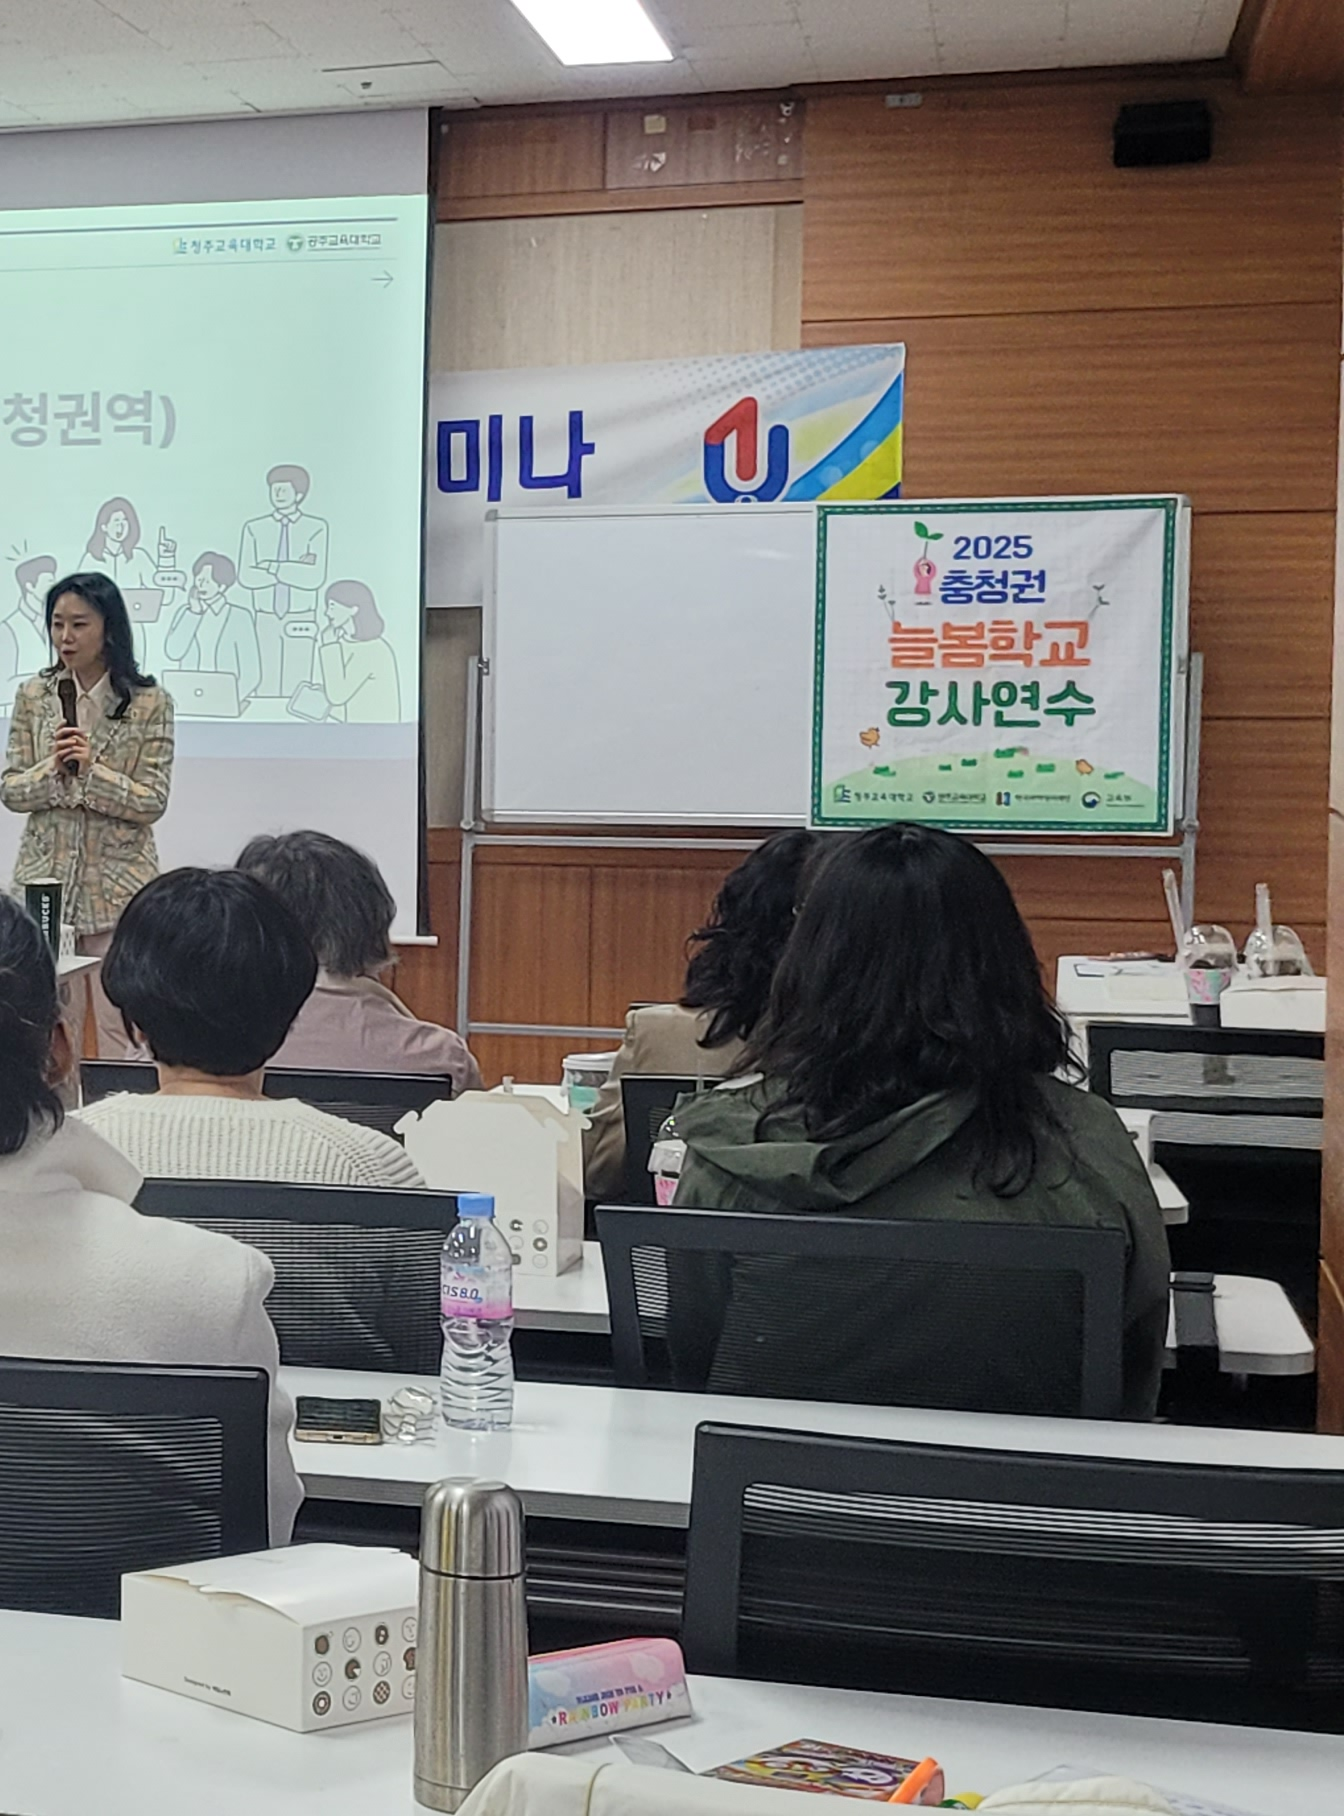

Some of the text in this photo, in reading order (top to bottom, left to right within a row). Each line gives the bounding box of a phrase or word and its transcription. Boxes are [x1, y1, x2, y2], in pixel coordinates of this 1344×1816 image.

[306, 234, 382, 247] 공주교육대학교
[437, 410, 595, 502] 미나
[953, 535, 1034, 560] 2025
[939, 569, 1046, 605] 충청권
[888, 620, 1092, 668] 늘봄학교
[885, 680, 1096, 728] 강사연수
[623, 1689, 665, 1714] PARTY
